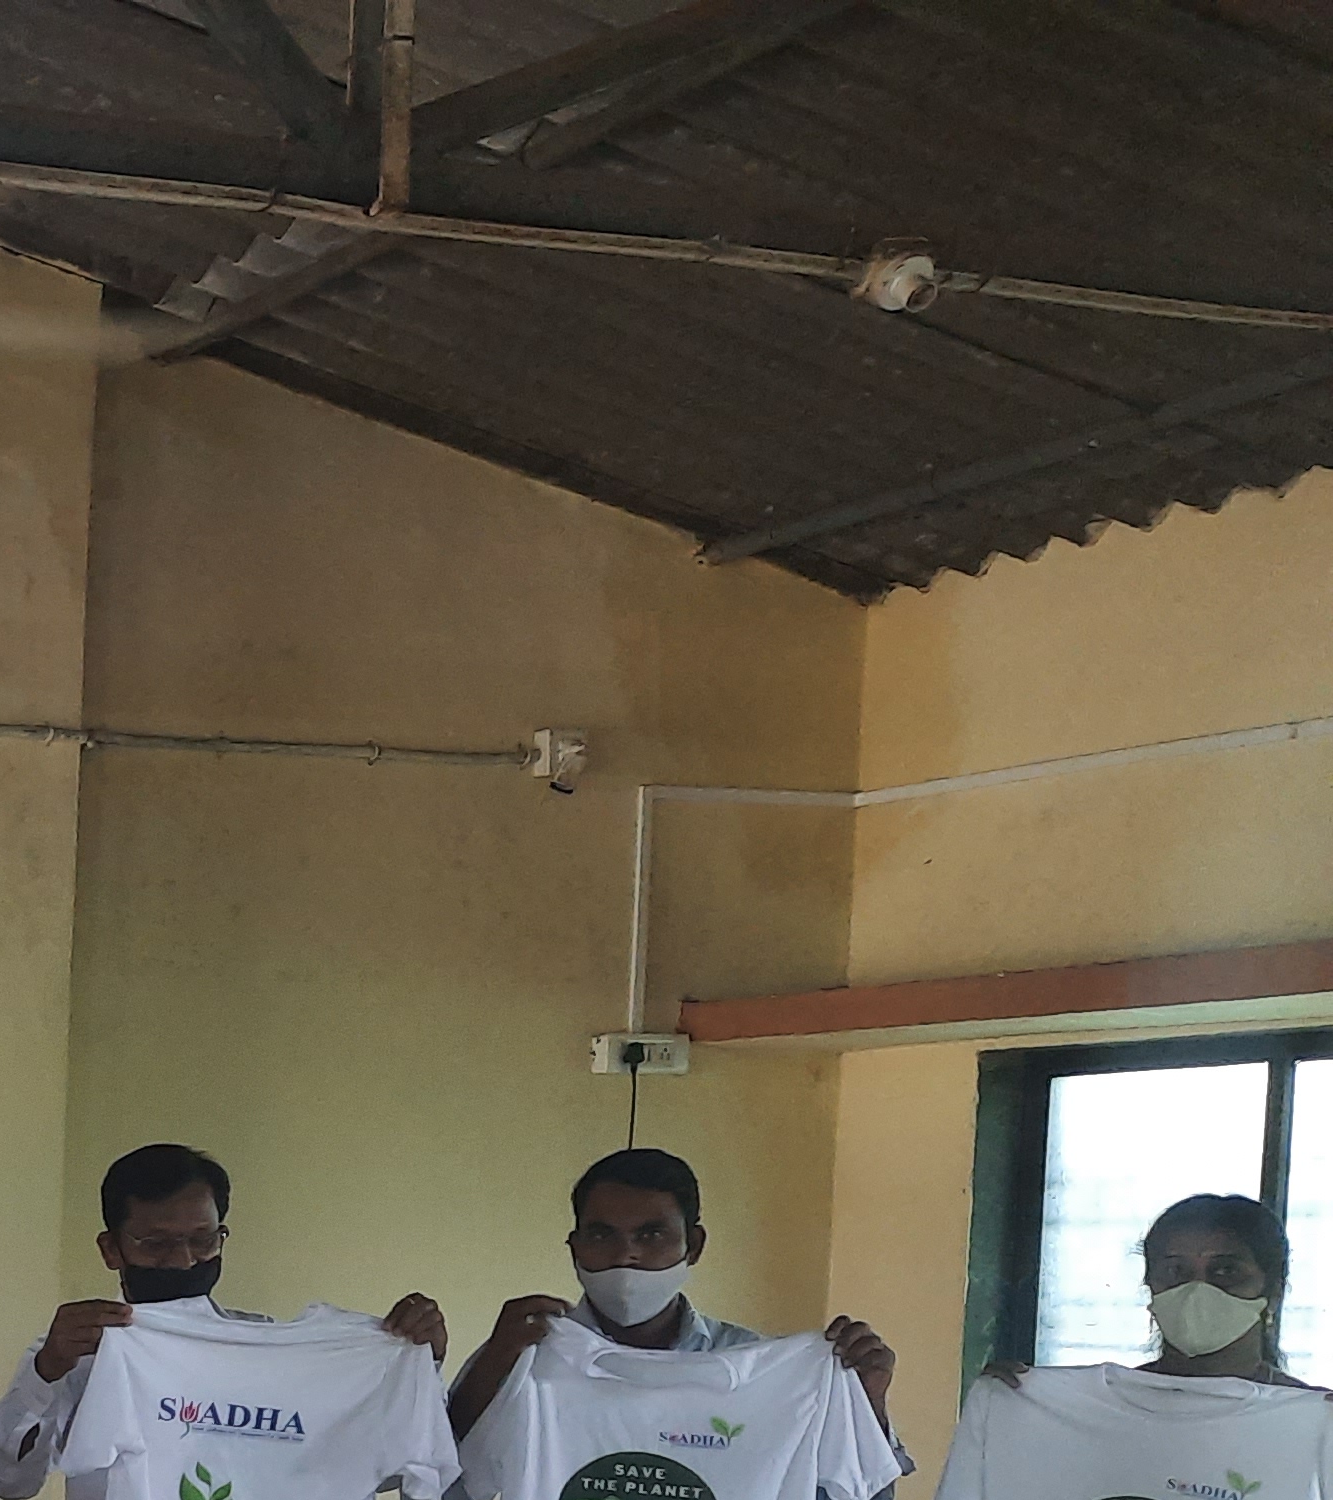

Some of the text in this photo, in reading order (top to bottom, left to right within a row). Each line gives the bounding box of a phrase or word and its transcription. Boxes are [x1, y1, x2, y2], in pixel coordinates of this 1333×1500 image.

[614, 1463, 666, 1479] SAVE
[581, 1477, 703, 1499] THE PLANET
